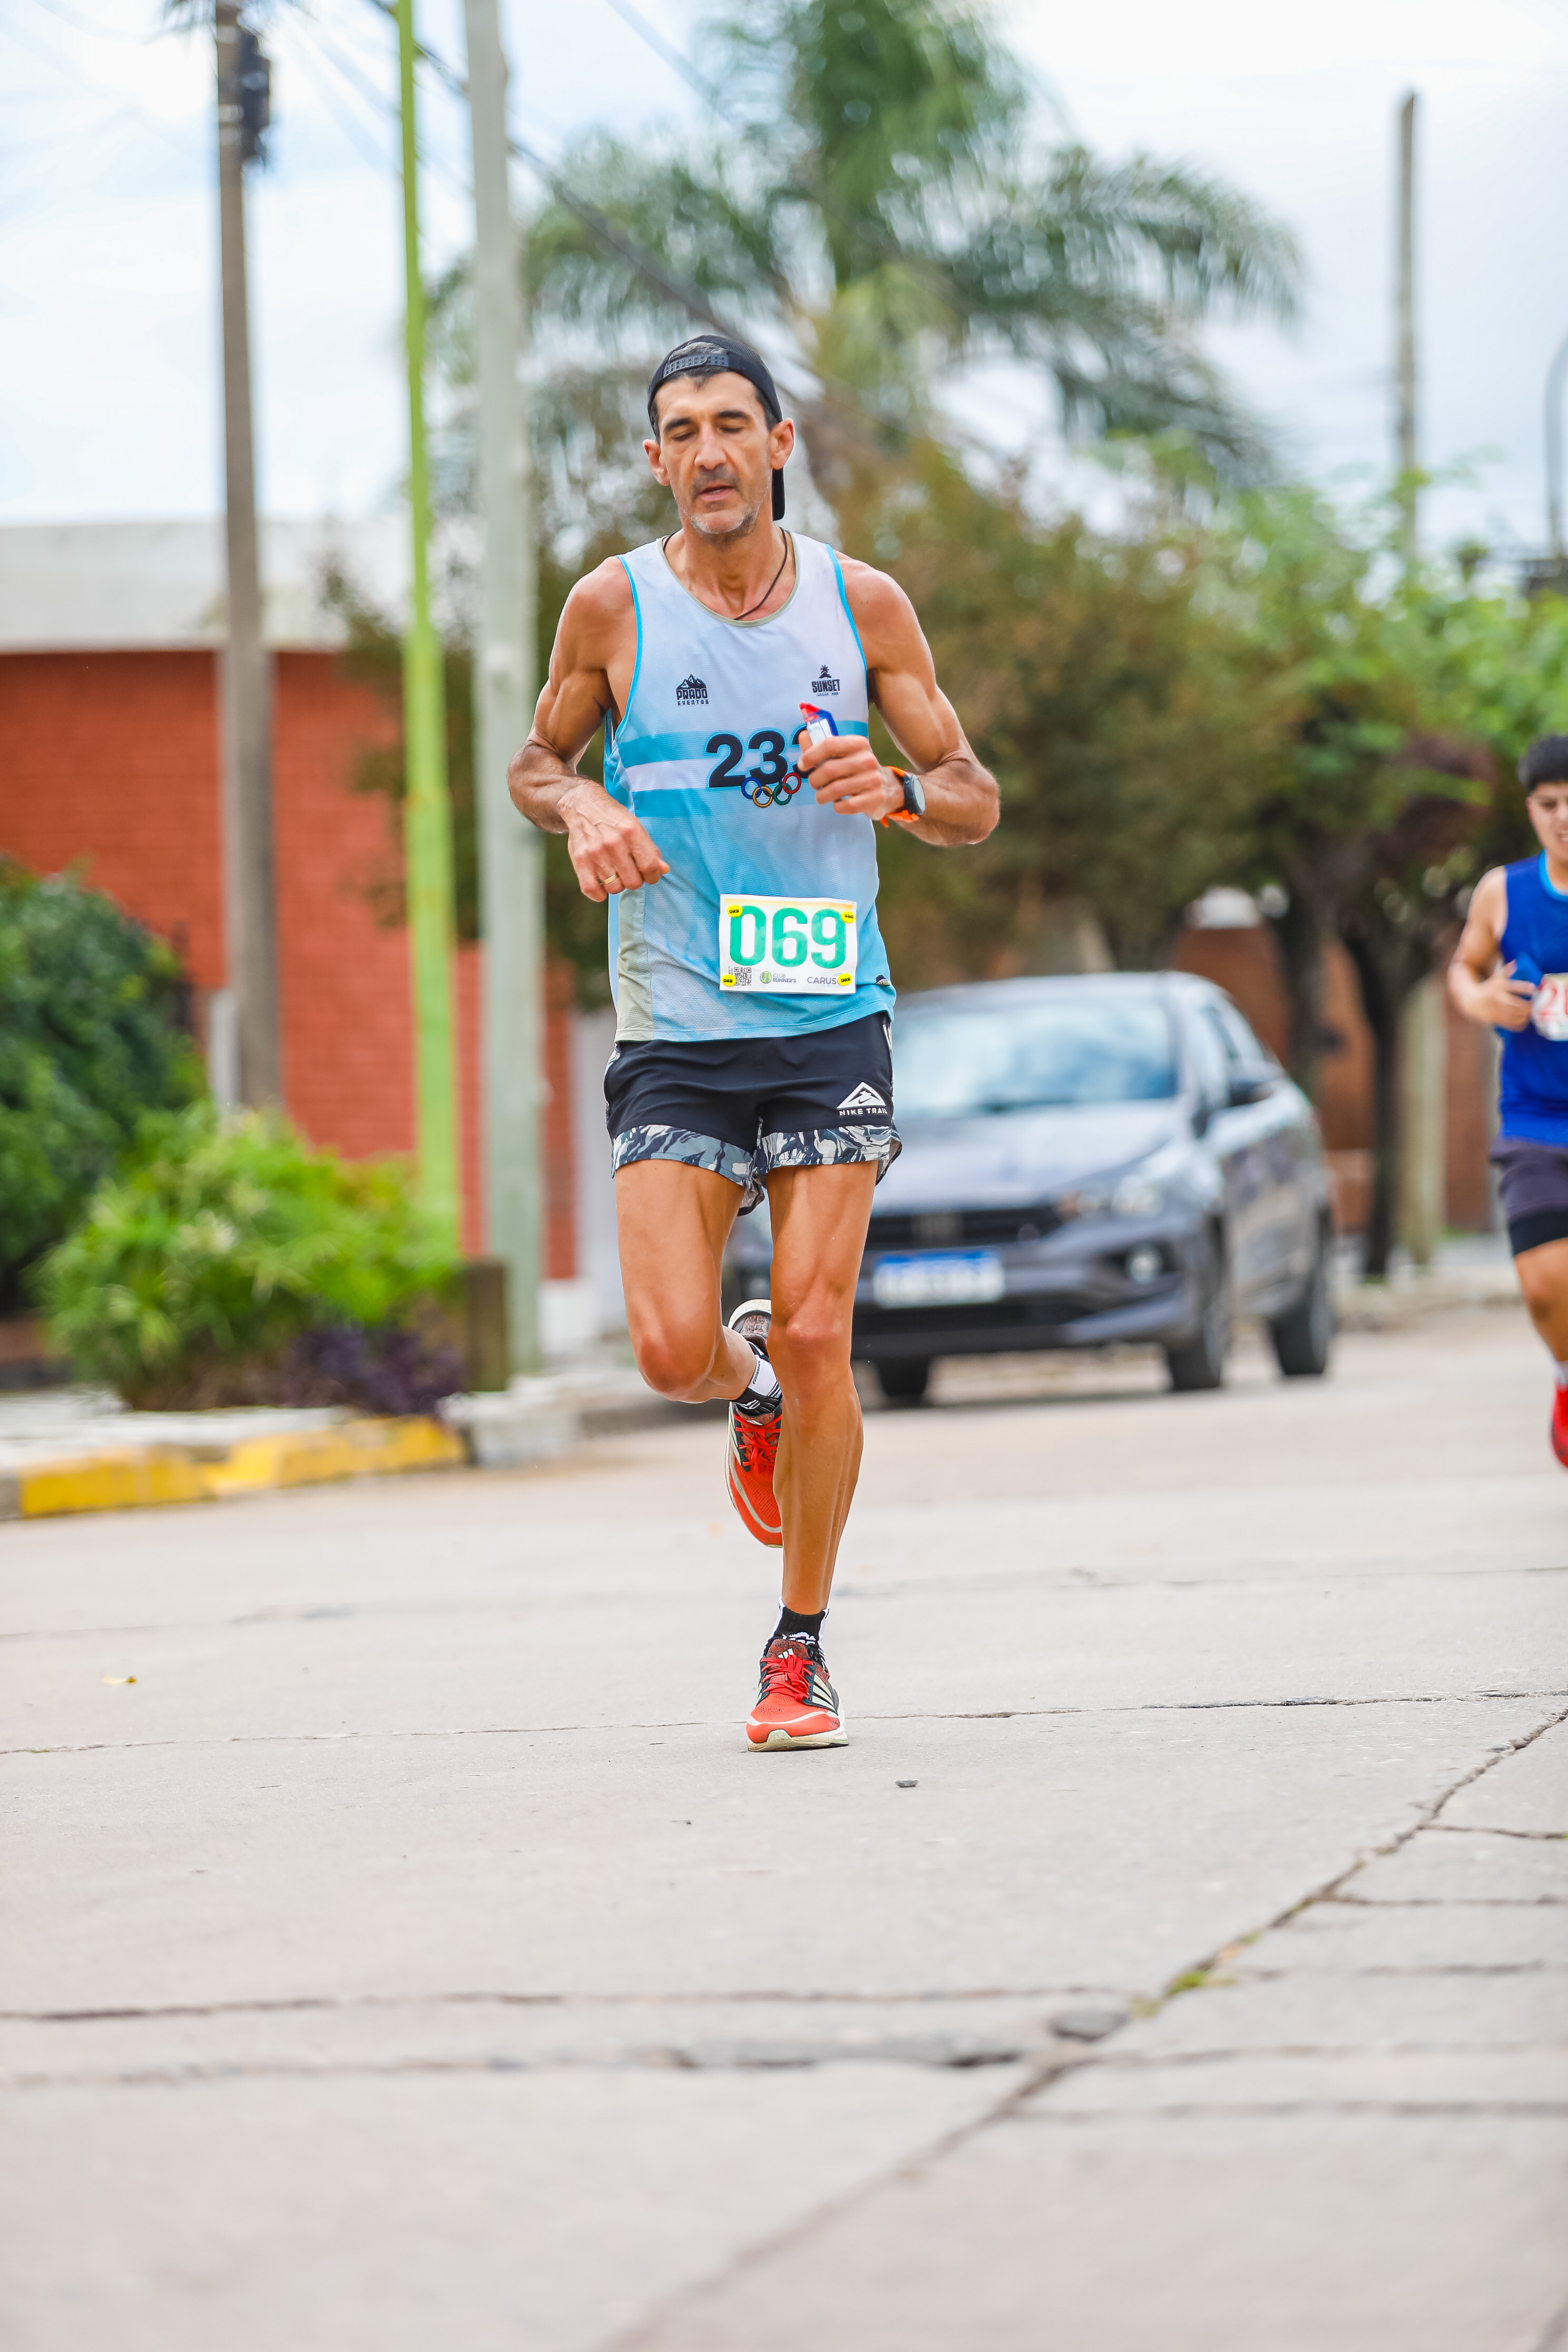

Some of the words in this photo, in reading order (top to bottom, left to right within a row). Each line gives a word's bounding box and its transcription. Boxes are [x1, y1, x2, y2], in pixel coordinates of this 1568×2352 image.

[812, 679, 840, 693] SUNSET
[677, 689, 708, 700] PRADO
[730, 905, 846, 968] 069
